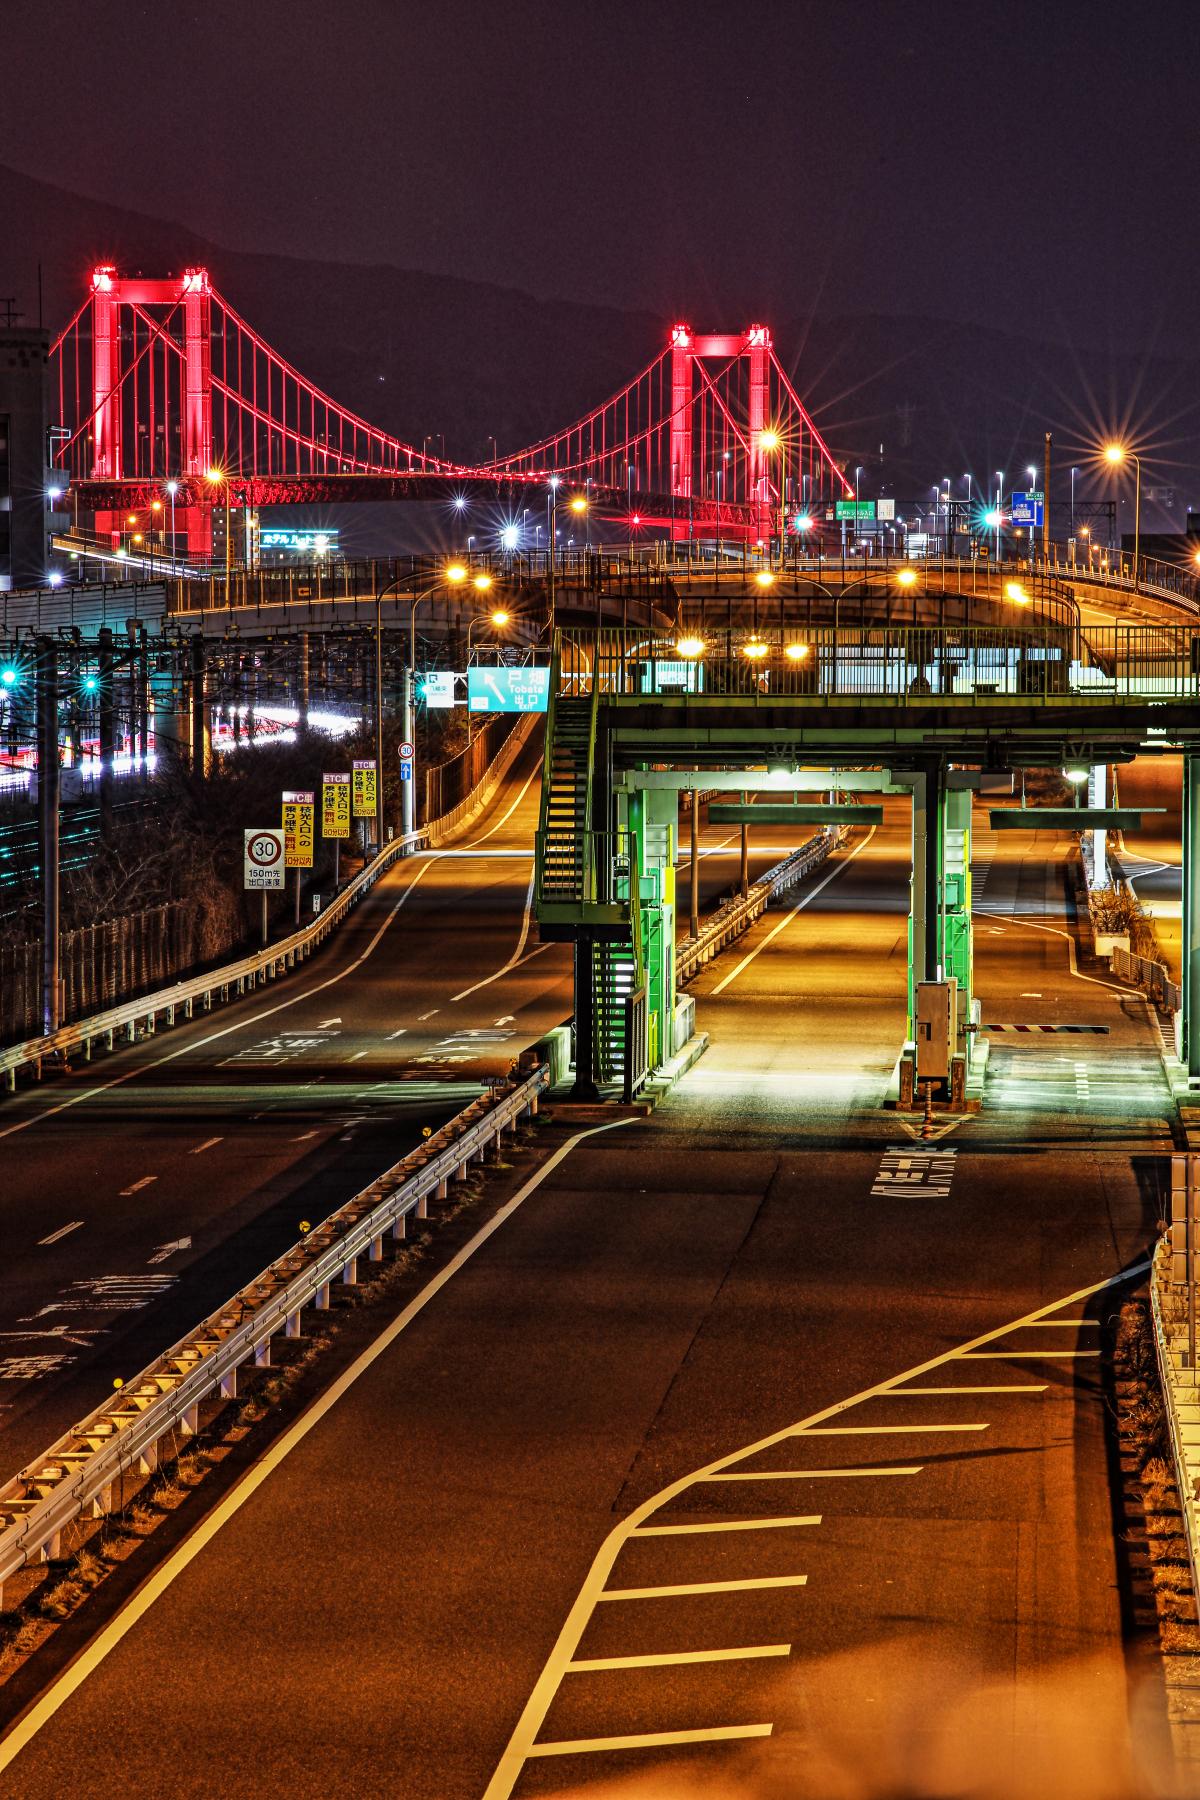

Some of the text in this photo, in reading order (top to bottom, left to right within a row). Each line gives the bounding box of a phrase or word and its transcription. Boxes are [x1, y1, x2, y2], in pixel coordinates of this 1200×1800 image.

[508, 670, 545, 685] 戸畑
[514, 695, 538, 705] 出口
[402, 746, 411, 755] 30
[353, 761, 376, 769] ETC車
[323, 775, 349, 783] ETC車
[323, 828, 348, 836] 90分以内
[255, 842, 274, 857] 30
[248, 869, 281, 878] 150m先
[248, 878, 281, 887] 出口速度
